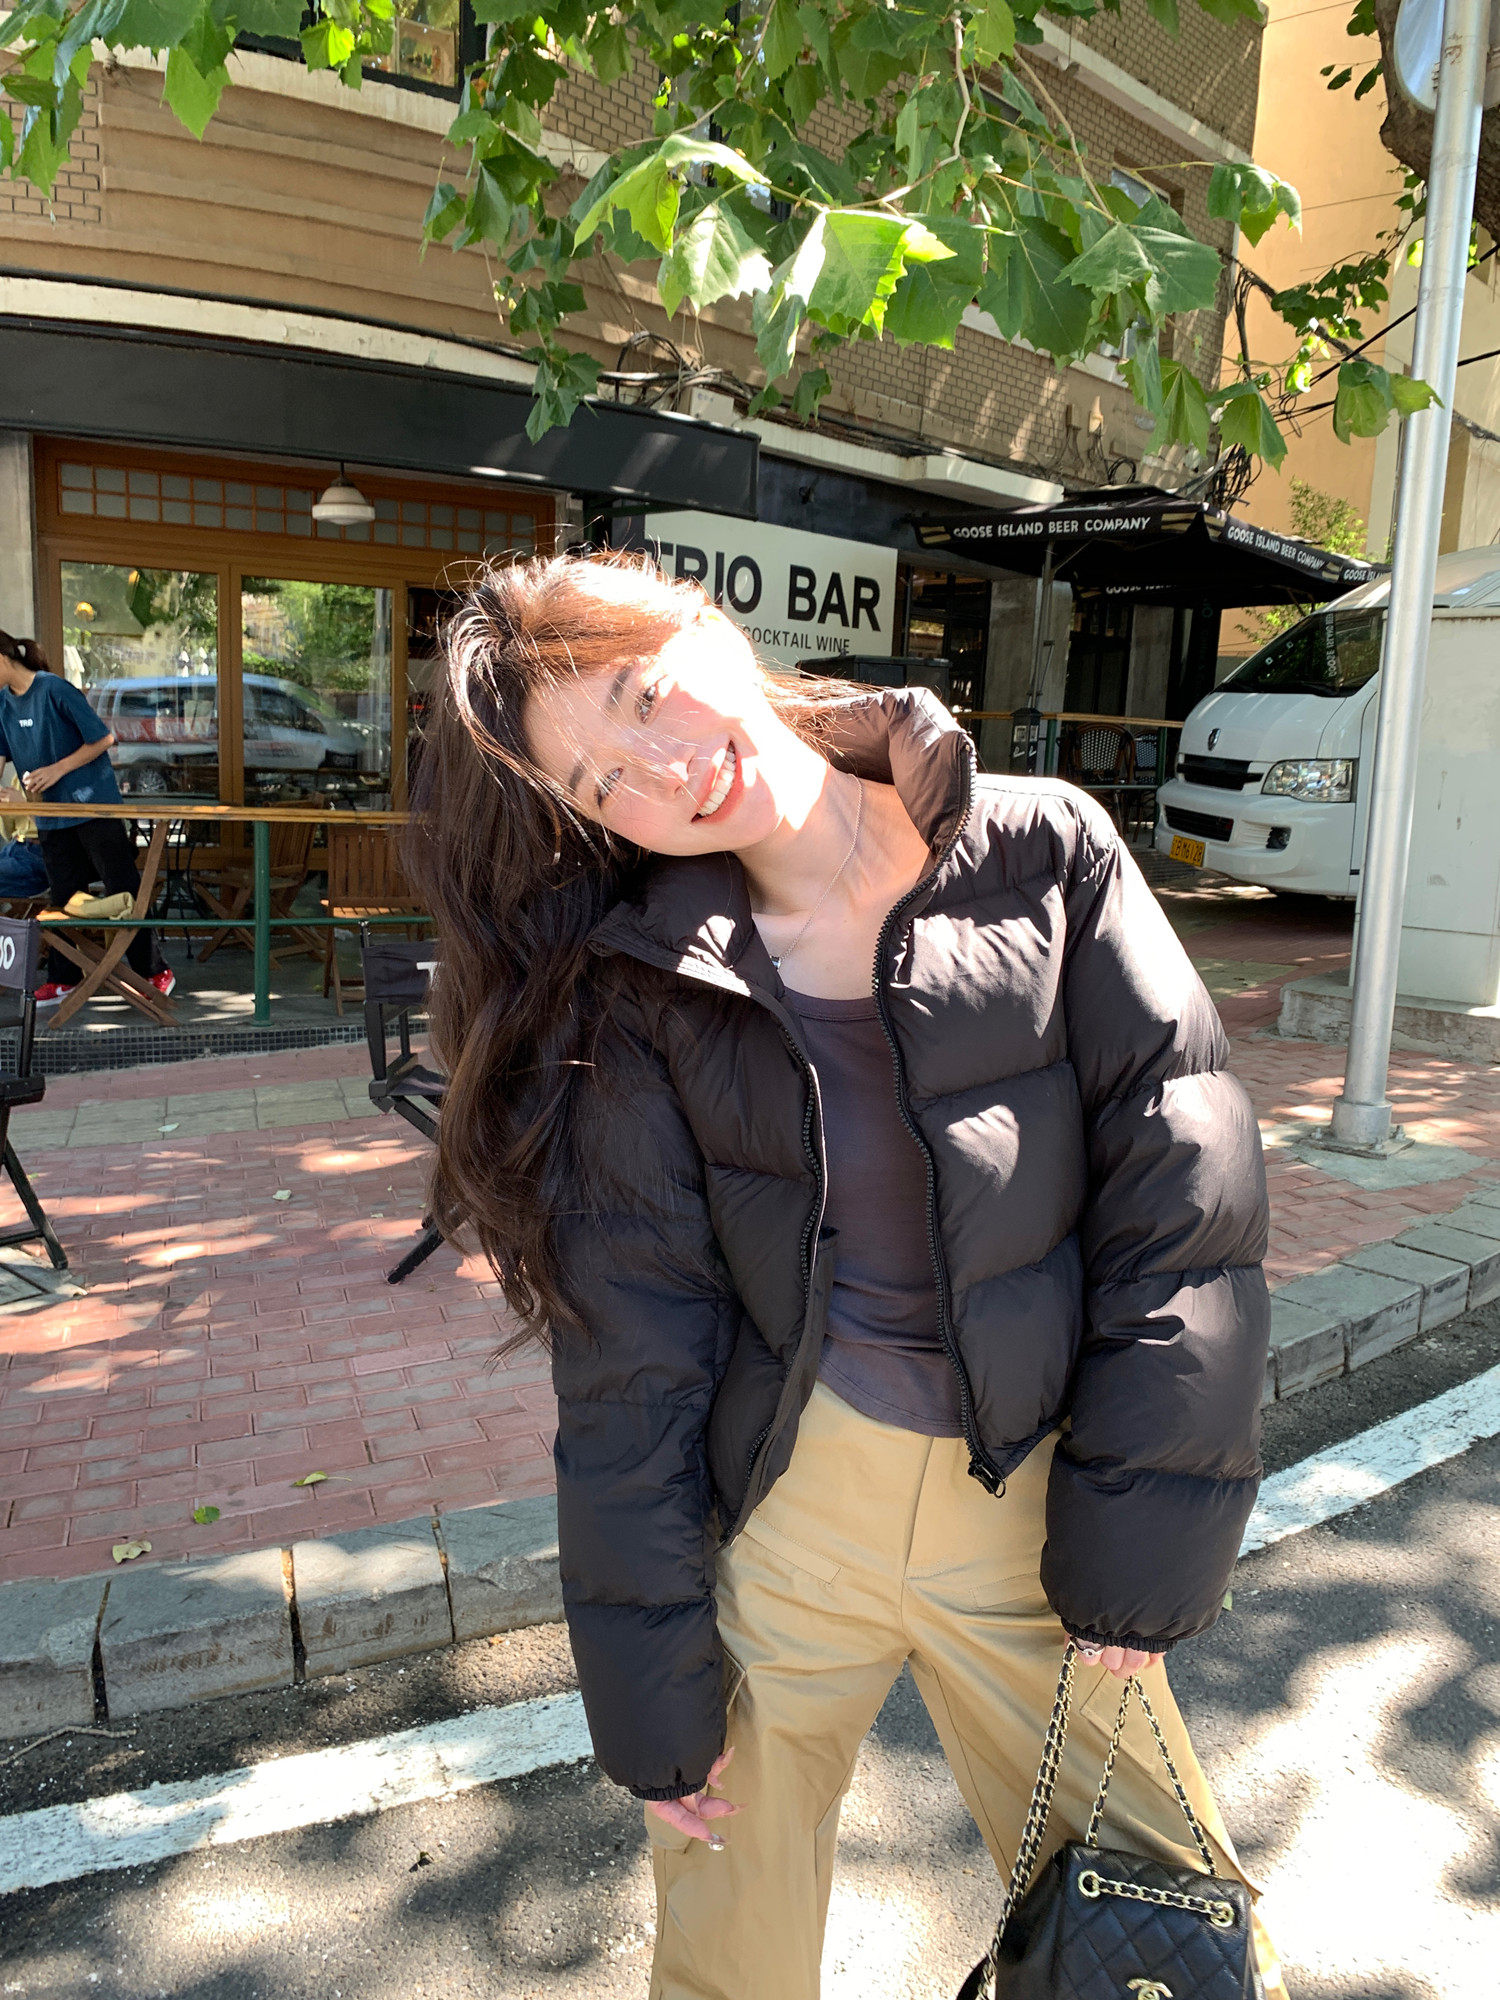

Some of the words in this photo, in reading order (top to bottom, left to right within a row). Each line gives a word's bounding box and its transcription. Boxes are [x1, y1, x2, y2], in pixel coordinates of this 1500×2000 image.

[953, 525, 993, 539] GOOSE
[997, 522, 1044, 537] ISLAND
[1048, 520, 1079, 534] BEER
[1084, 516, 1151, 532] COMPANY
[1227, 525, 1255, 544] GOOSE
[1255, 533, 1280, 553] ISLAND
[1280, 543, 1296, 559] BEER
[1297, 550, 1325, 570] COMPANY
[1343, 569, 1366, 581] GOOSE
[787, 564, 881, 631] BAR
[816, 636, 850, 655] WINE
